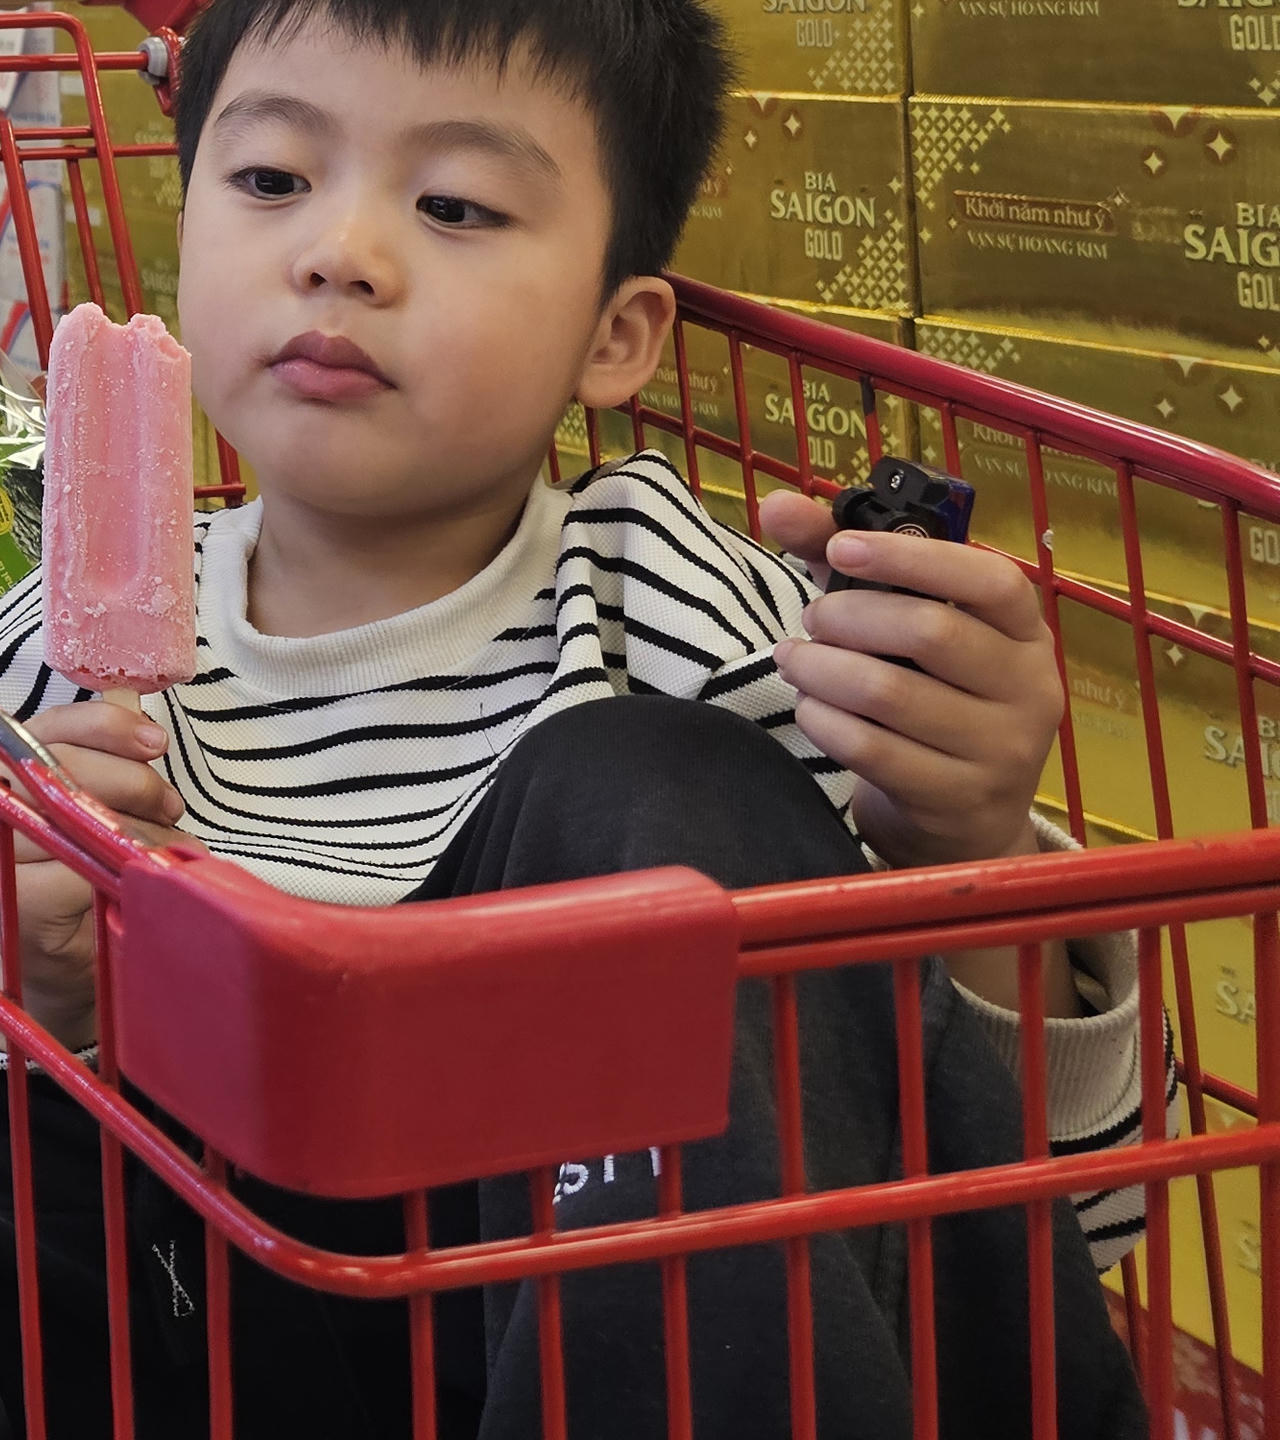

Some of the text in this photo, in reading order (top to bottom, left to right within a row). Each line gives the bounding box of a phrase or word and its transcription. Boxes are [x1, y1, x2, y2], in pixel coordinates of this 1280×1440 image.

[796, 20, 834, 48] GOLD
[804, 171, 837, 194] BIA
[770, 189, 877, 230] SAIGON
[964, 197, 1005, 219] Khởi
[1008, 200, 1050, 224] năm
[804, 227, 843, 261] GOLD
[1184, 224, 1280, 267] SAIG
[1237, 271, 1280, 311] GOL
[764, 392, 868, 441] SAGON
[808, 438, 836, 469] OLD
